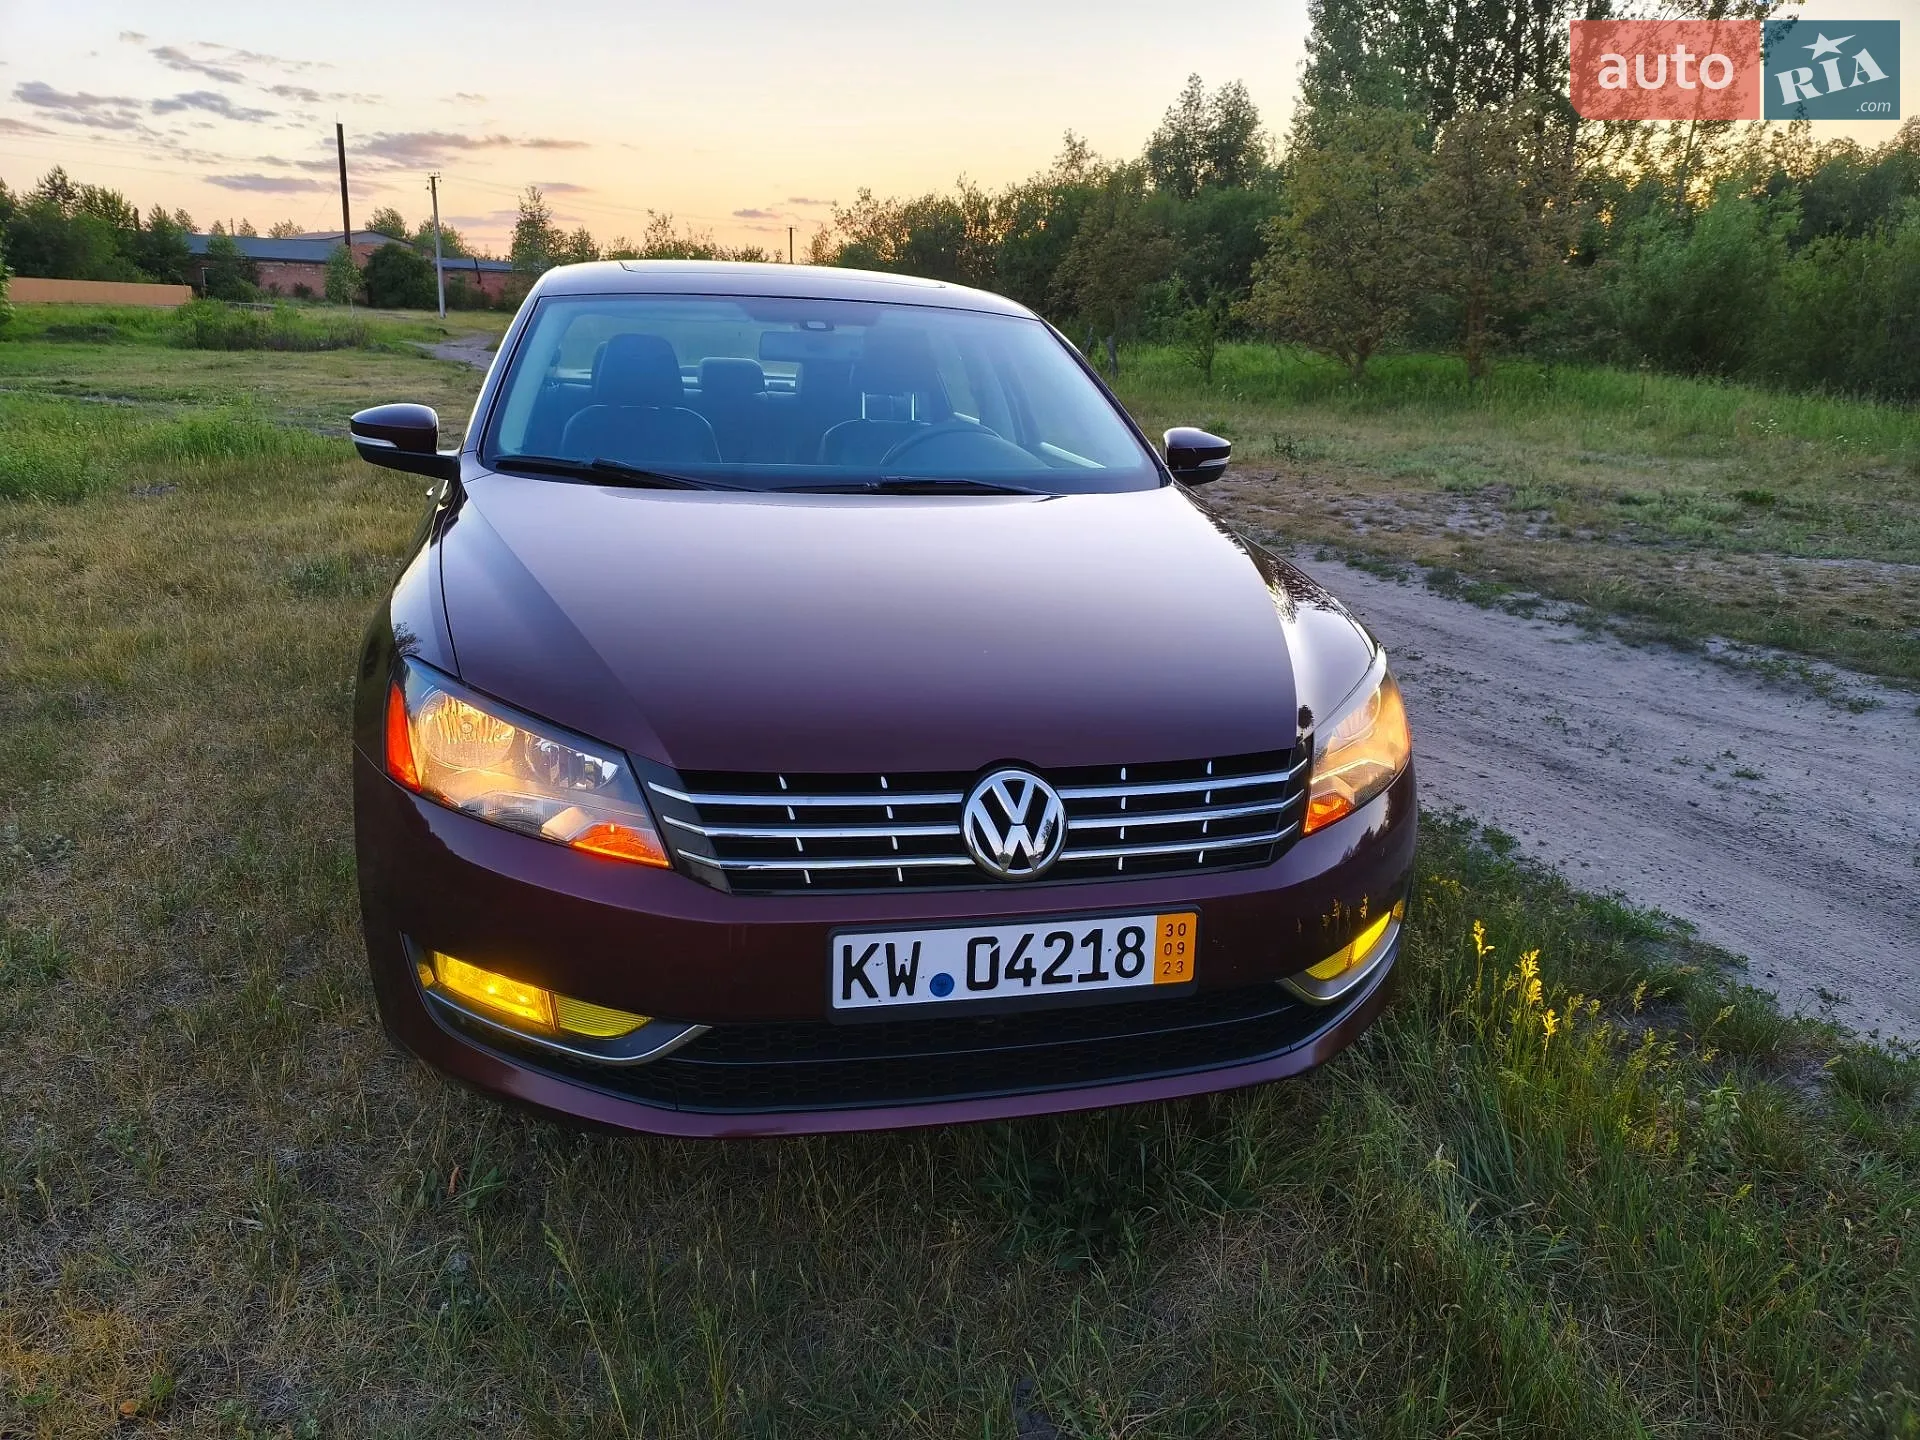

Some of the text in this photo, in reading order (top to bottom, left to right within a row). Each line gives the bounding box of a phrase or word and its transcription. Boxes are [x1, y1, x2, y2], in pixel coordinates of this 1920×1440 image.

[1165, 922, 1187, 937] 30
[1163, 942, 1186, 956] 09
[841, 925, 1146, 1000] KW 04218
[1162, 960, 1185, 975] 23
